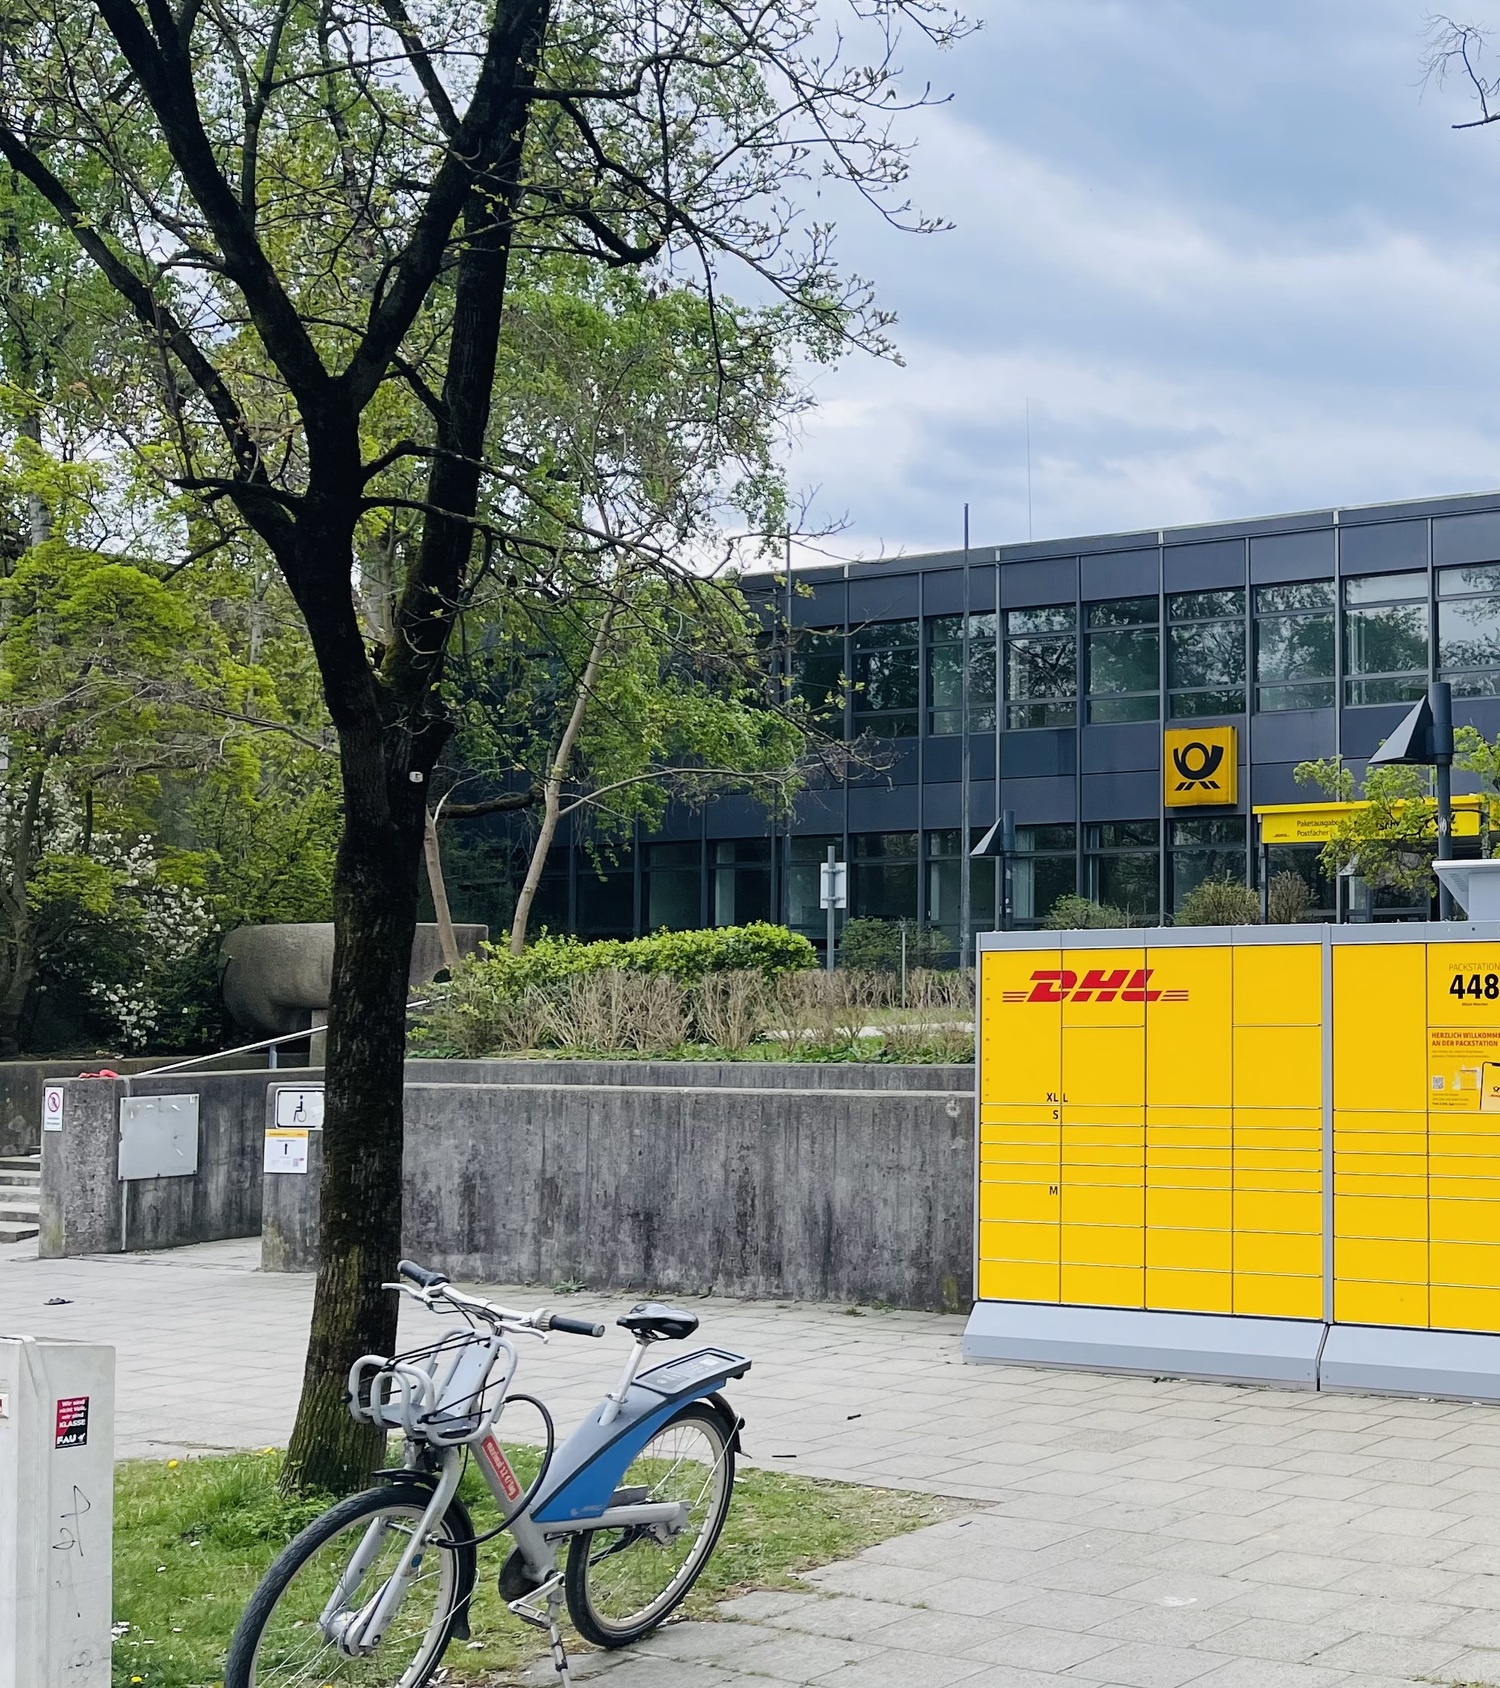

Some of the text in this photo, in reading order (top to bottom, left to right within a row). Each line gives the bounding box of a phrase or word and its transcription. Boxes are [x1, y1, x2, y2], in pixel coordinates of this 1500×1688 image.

[1449, 962, 1500, 971] PACKSTATION
[1026, 968, 1162, 1003] DHL
[1449, 973, 1500, 1000] 448
[1046, 1092, 1059, 1102] XL
[1063, 1093, 1068, 1102] L
[1053, 1110, 1059, 1119] S
[1049, 1185, 1058, 1196] M
[59, 1419, 86, 1428] KLASSE
[57, 1434, 77, 1444] FAU
